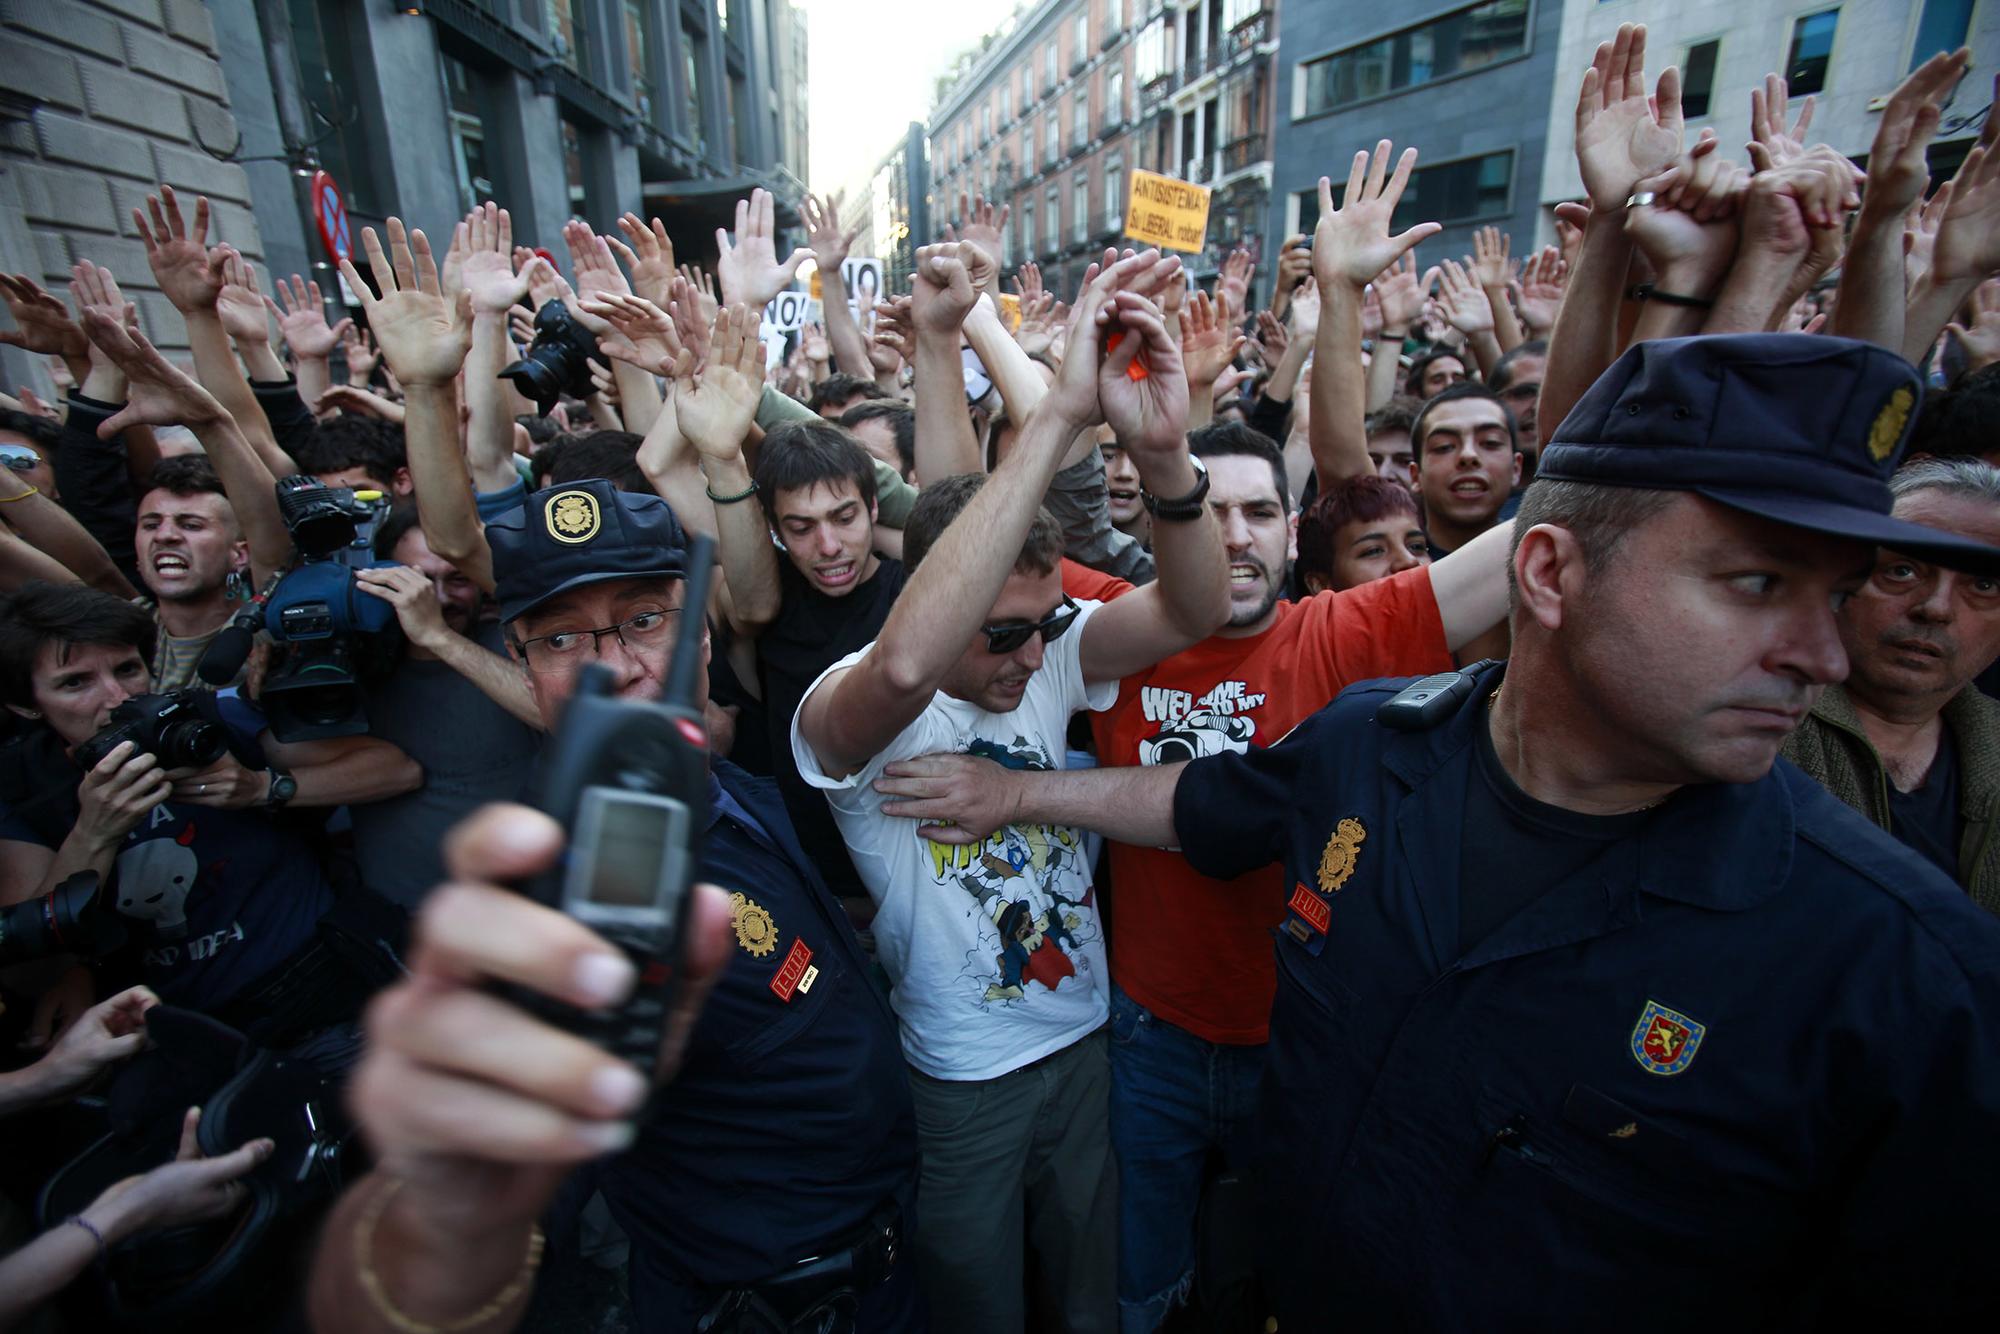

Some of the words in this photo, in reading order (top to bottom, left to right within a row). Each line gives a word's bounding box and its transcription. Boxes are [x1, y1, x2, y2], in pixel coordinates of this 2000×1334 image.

[1141, 681, 1246, 721] WELME
[1236, 693, 1266, 712] MY
[143, 945, 181, 967] AD
[187, 920, 245, 961] IDEA
